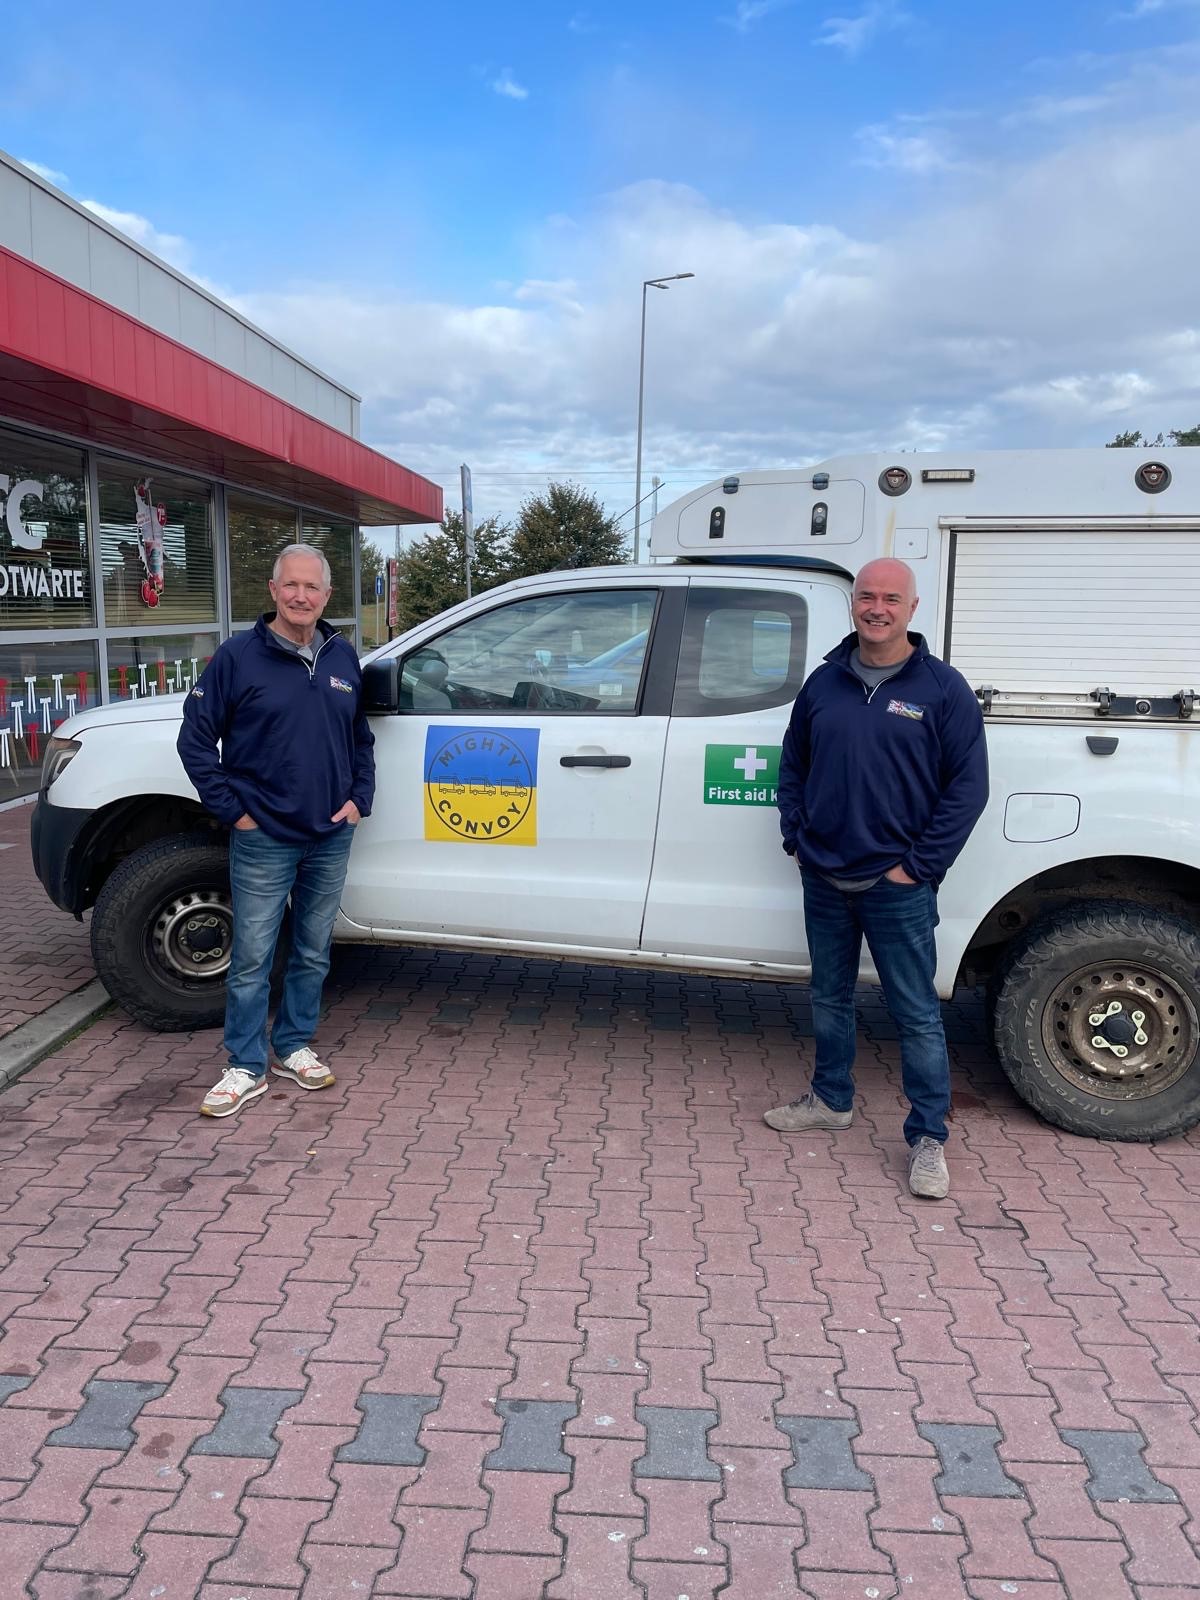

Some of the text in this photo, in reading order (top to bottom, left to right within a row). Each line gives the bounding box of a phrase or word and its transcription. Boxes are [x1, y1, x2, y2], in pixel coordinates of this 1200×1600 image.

[0, 473, 43, 550] C
[439, 736, 522, 768] MIGHTY
[708, 786, 741, 800] First
[744, 788, 767, 801] aid
[438, 799, 521, 835] CONVOY
